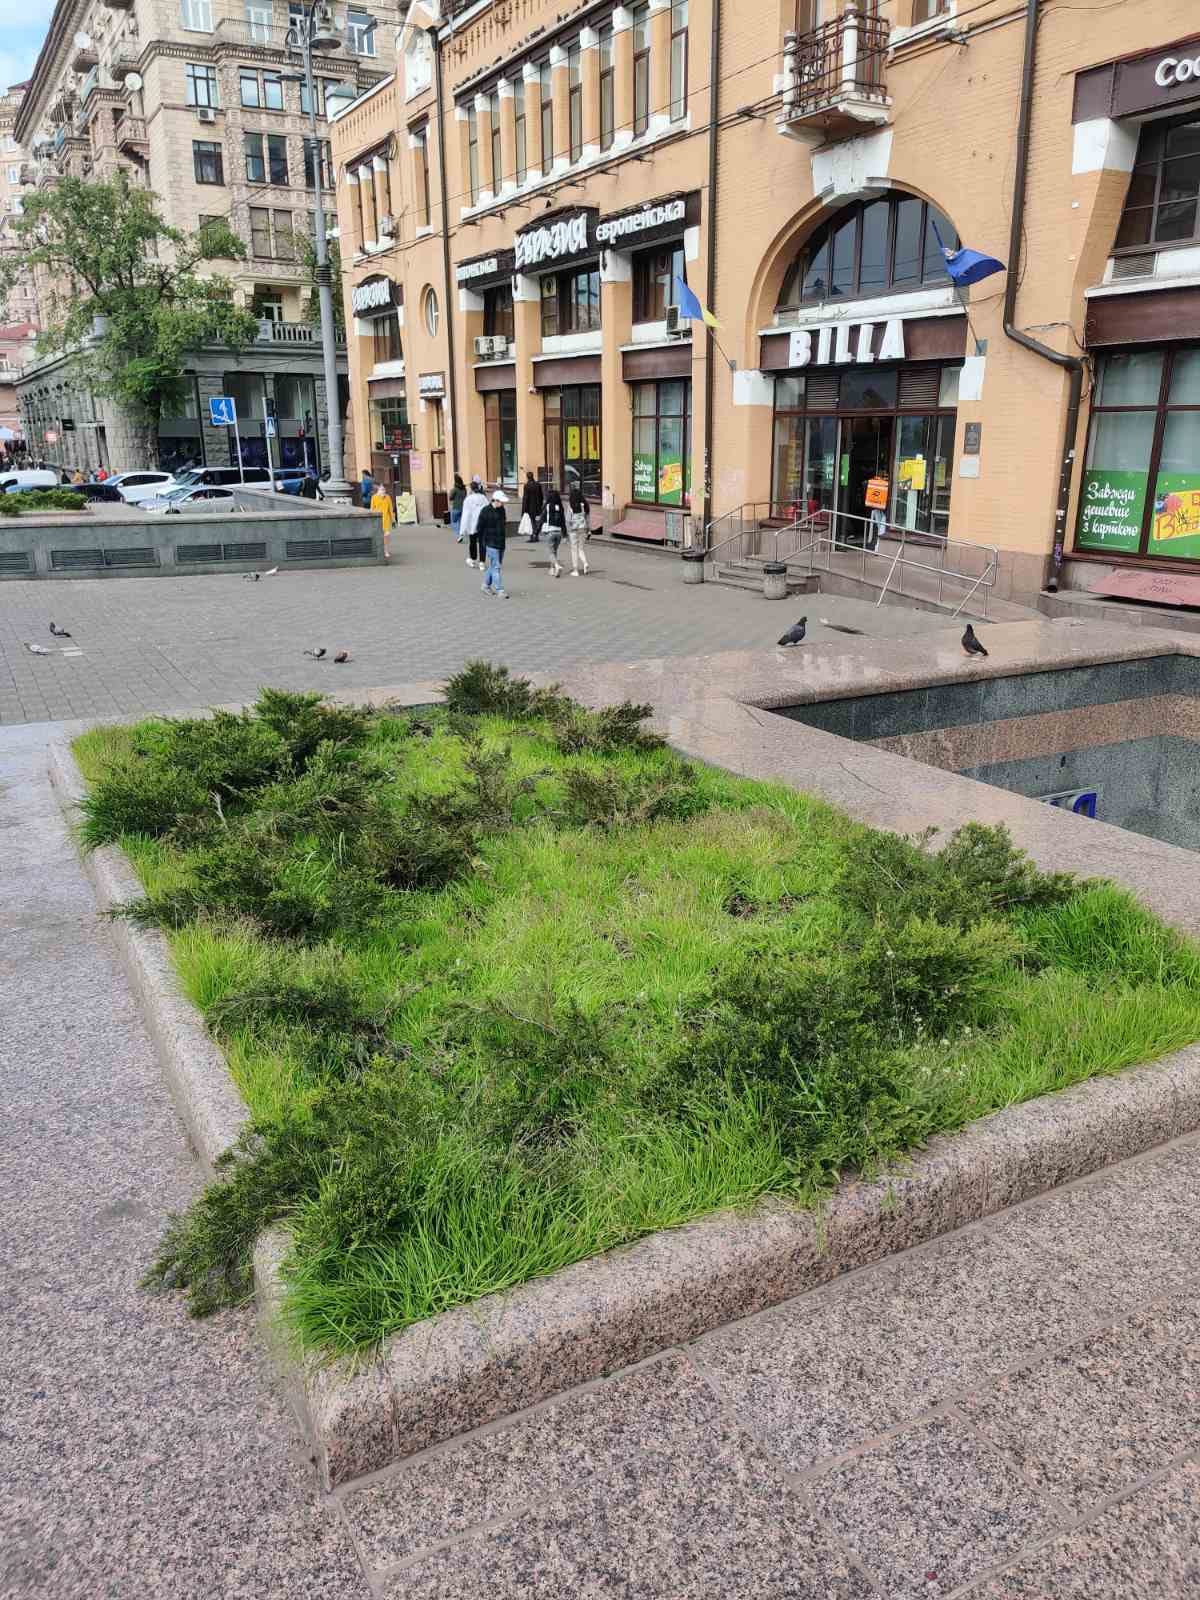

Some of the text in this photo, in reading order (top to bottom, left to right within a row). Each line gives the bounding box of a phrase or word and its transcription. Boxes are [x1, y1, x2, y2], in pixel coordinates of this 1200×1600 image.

[596, 200, 686, 244] європейська
[789, 319, 905, 368] BILLA
[1086, 482, 1136, 505] Завжди
[1083, 501, 1130, 520] дешевше
[1083, 522, 1089, 533] з
[1092, 518, 1138, 539] карткою
